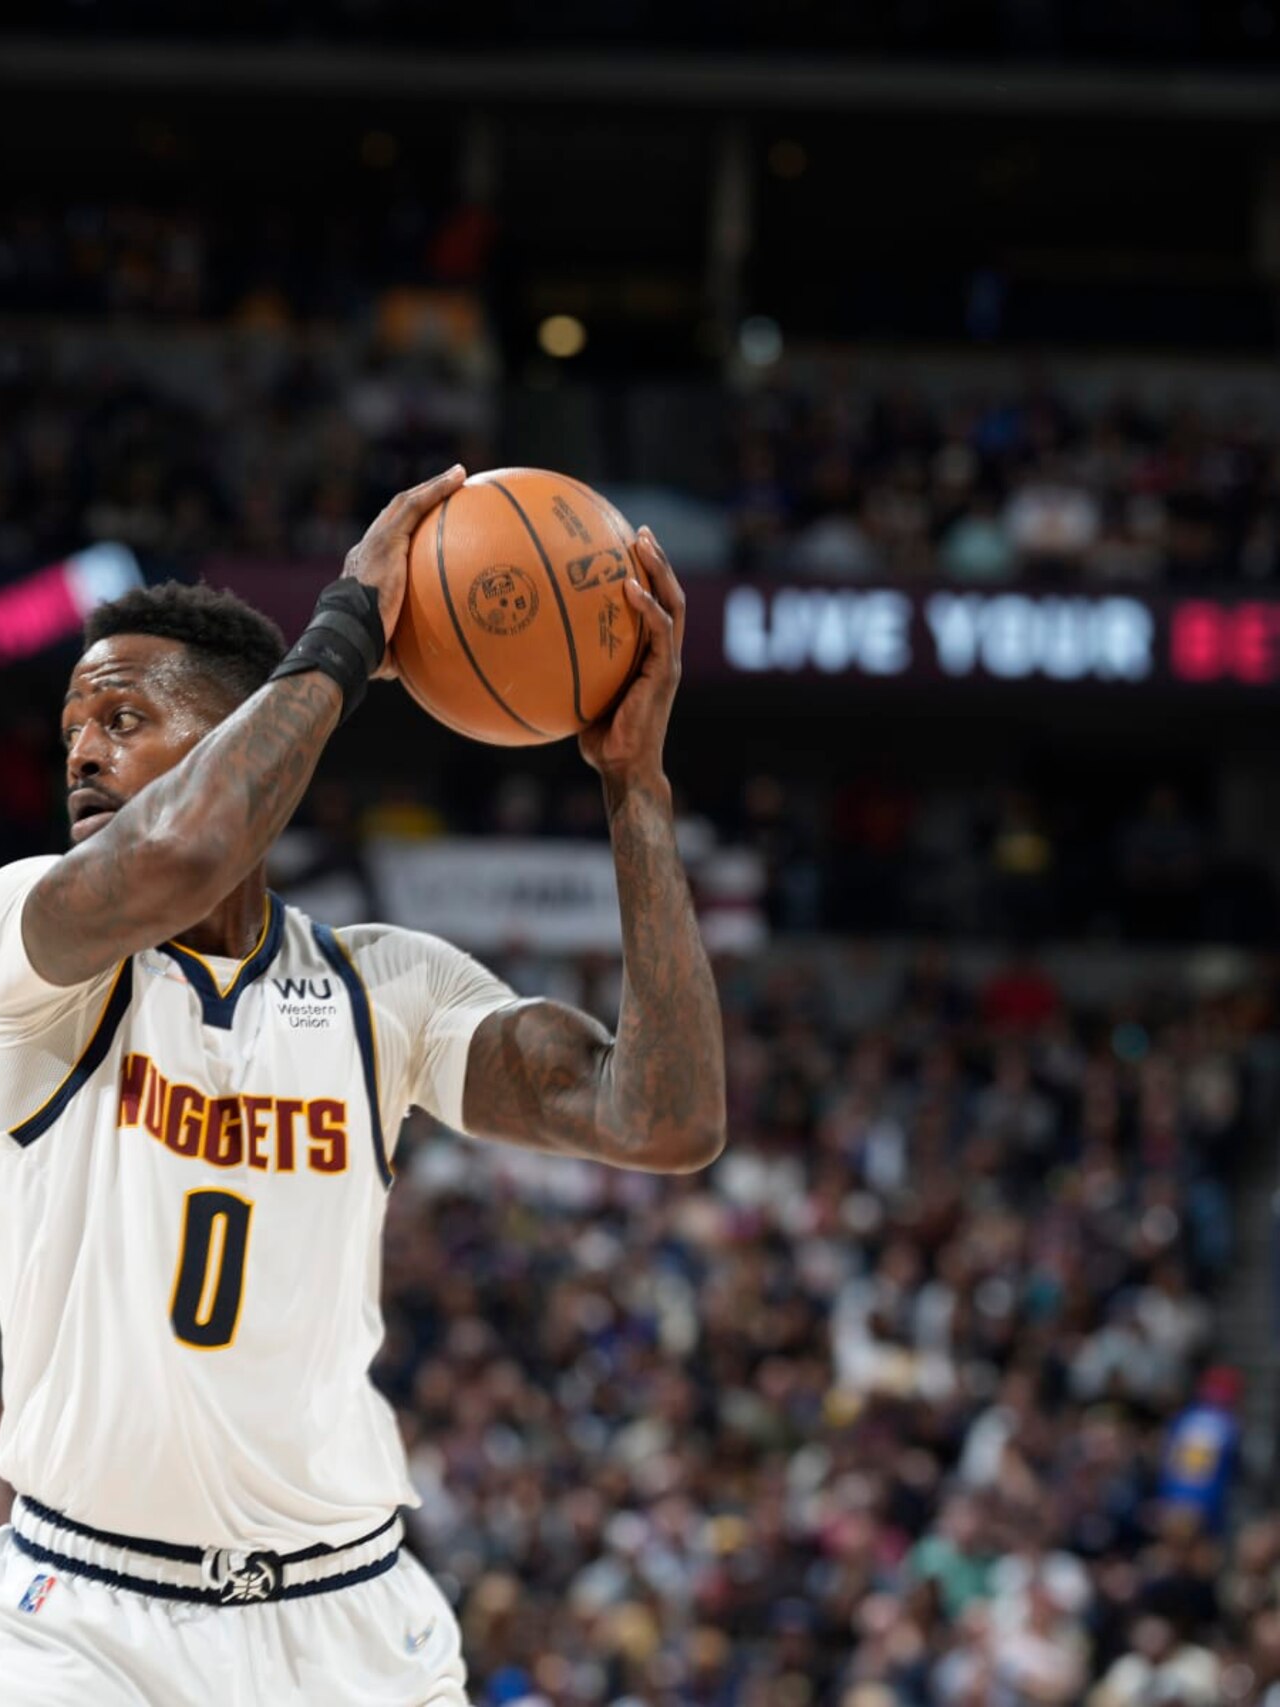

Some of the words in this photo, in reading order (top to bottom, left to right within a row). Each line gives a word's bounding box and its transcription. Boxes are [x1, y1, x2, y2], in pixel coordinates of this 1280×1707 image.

[723, 588, 909, 675] LIVE
[926, 593, 1154, 682] YOUR
[271, 977, 332, 1001] WU
[277, 1003, 337, 1016] Western
[289, 1015, 330, 1028] Union
[117, 1052, 348, 1177] NUGGETS
[169, 1185, 255, 1351] 0
